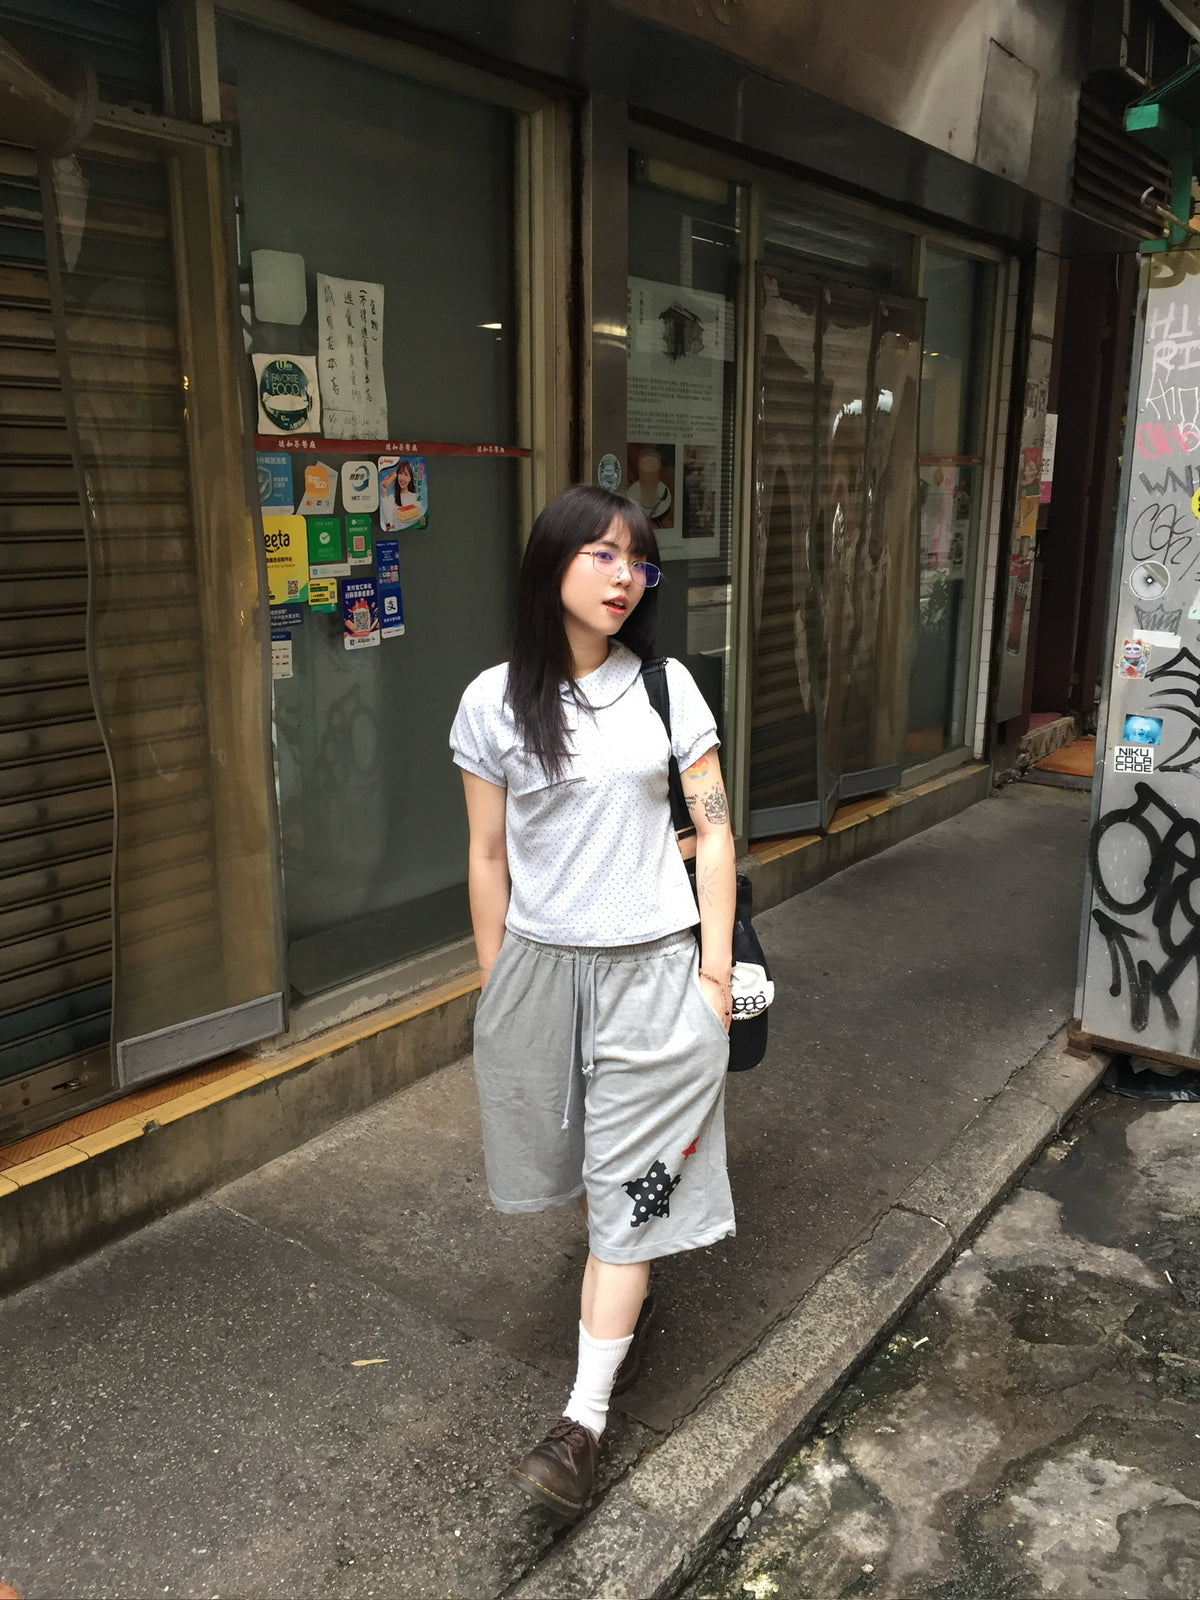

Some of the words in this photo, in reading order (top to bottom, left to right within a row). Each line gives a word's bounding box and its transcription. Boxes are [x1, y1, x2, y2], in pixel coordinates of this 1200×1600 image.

[271, 383, 300, 396] FOOD
[1118, 747, 1149, 757] NIKU
[1115, 755, 1152, 764] COLA
[1115, 764, 1152, 773] CHOE
